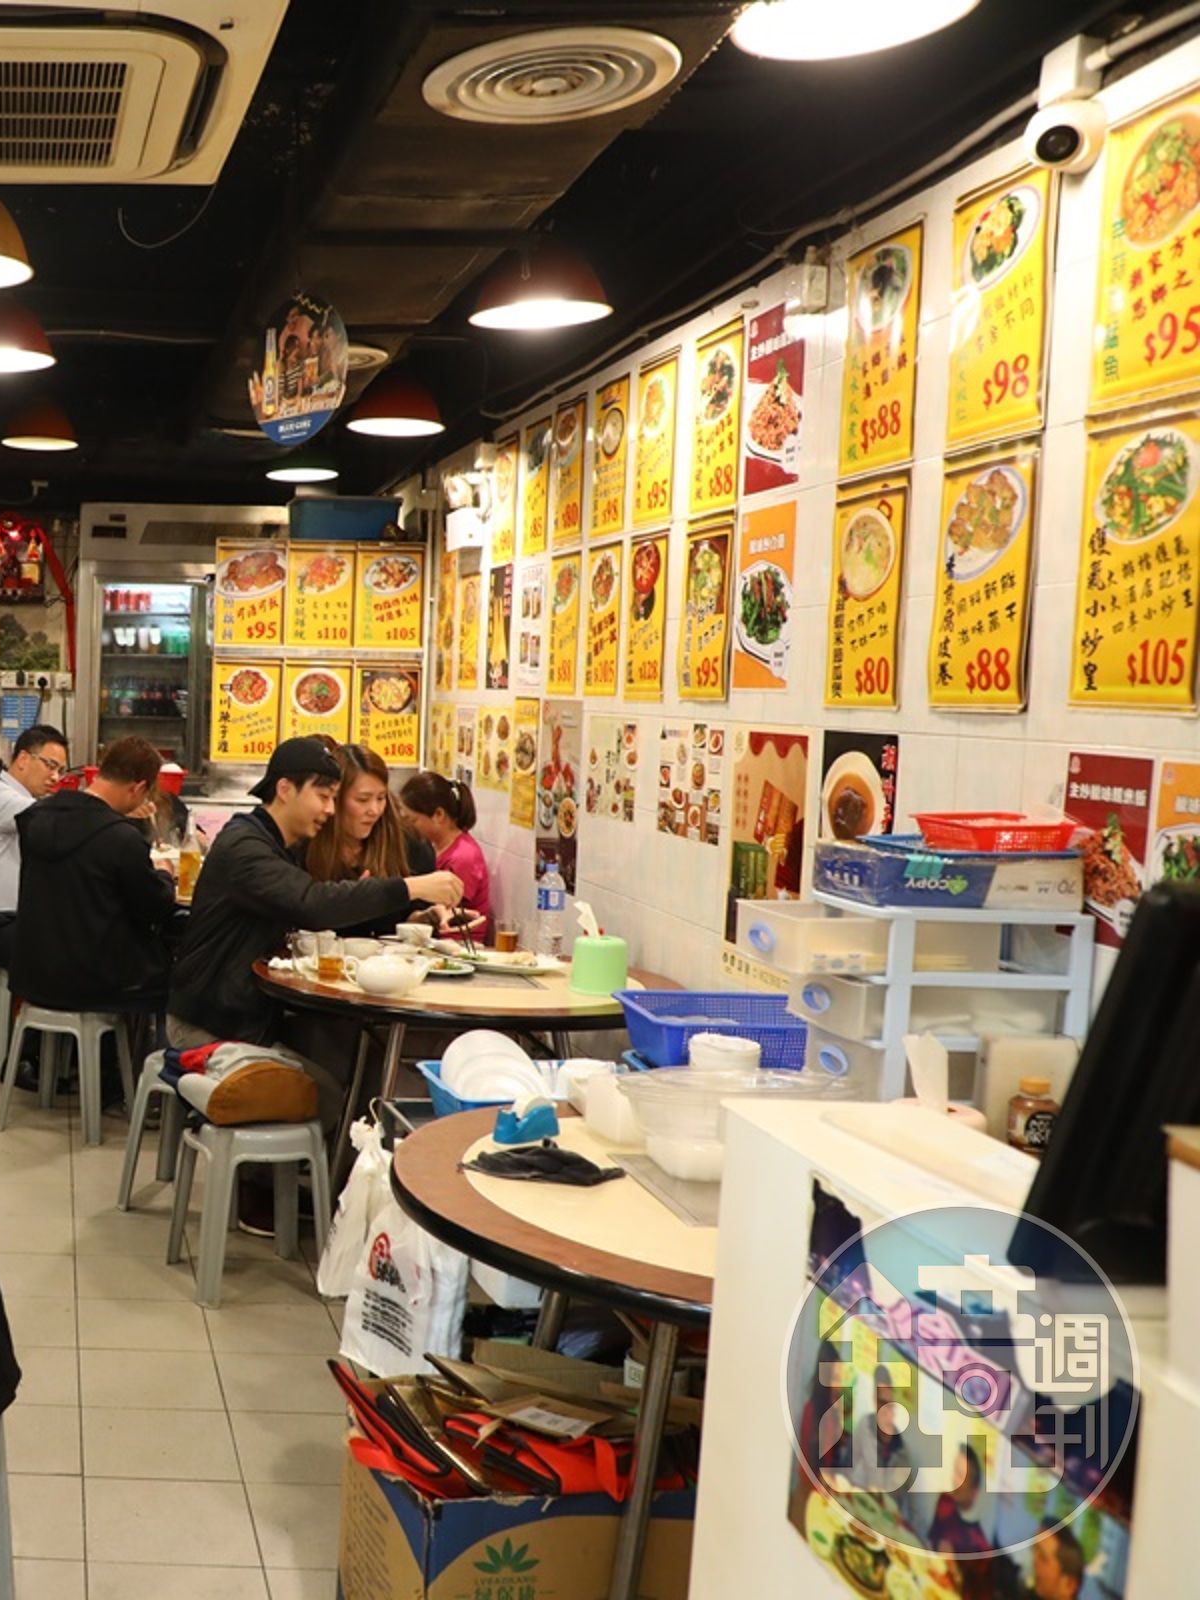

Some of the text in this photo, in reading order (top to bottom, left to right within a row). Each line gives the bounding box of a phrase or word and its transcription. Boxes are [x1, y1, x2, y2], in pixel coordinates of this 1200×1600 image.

[1143, 304, 1200, 368] $95
[983, 353, 1030, 411] $98
[708, 463, 733, 499] $88
[246, 620, 278, 640] $95
[696, 656, 719, 688] $95
[855, 656, 890, 697] $80
[965, 647, 1011, 694] $88
[1127, 638, 1188, 687] $105
